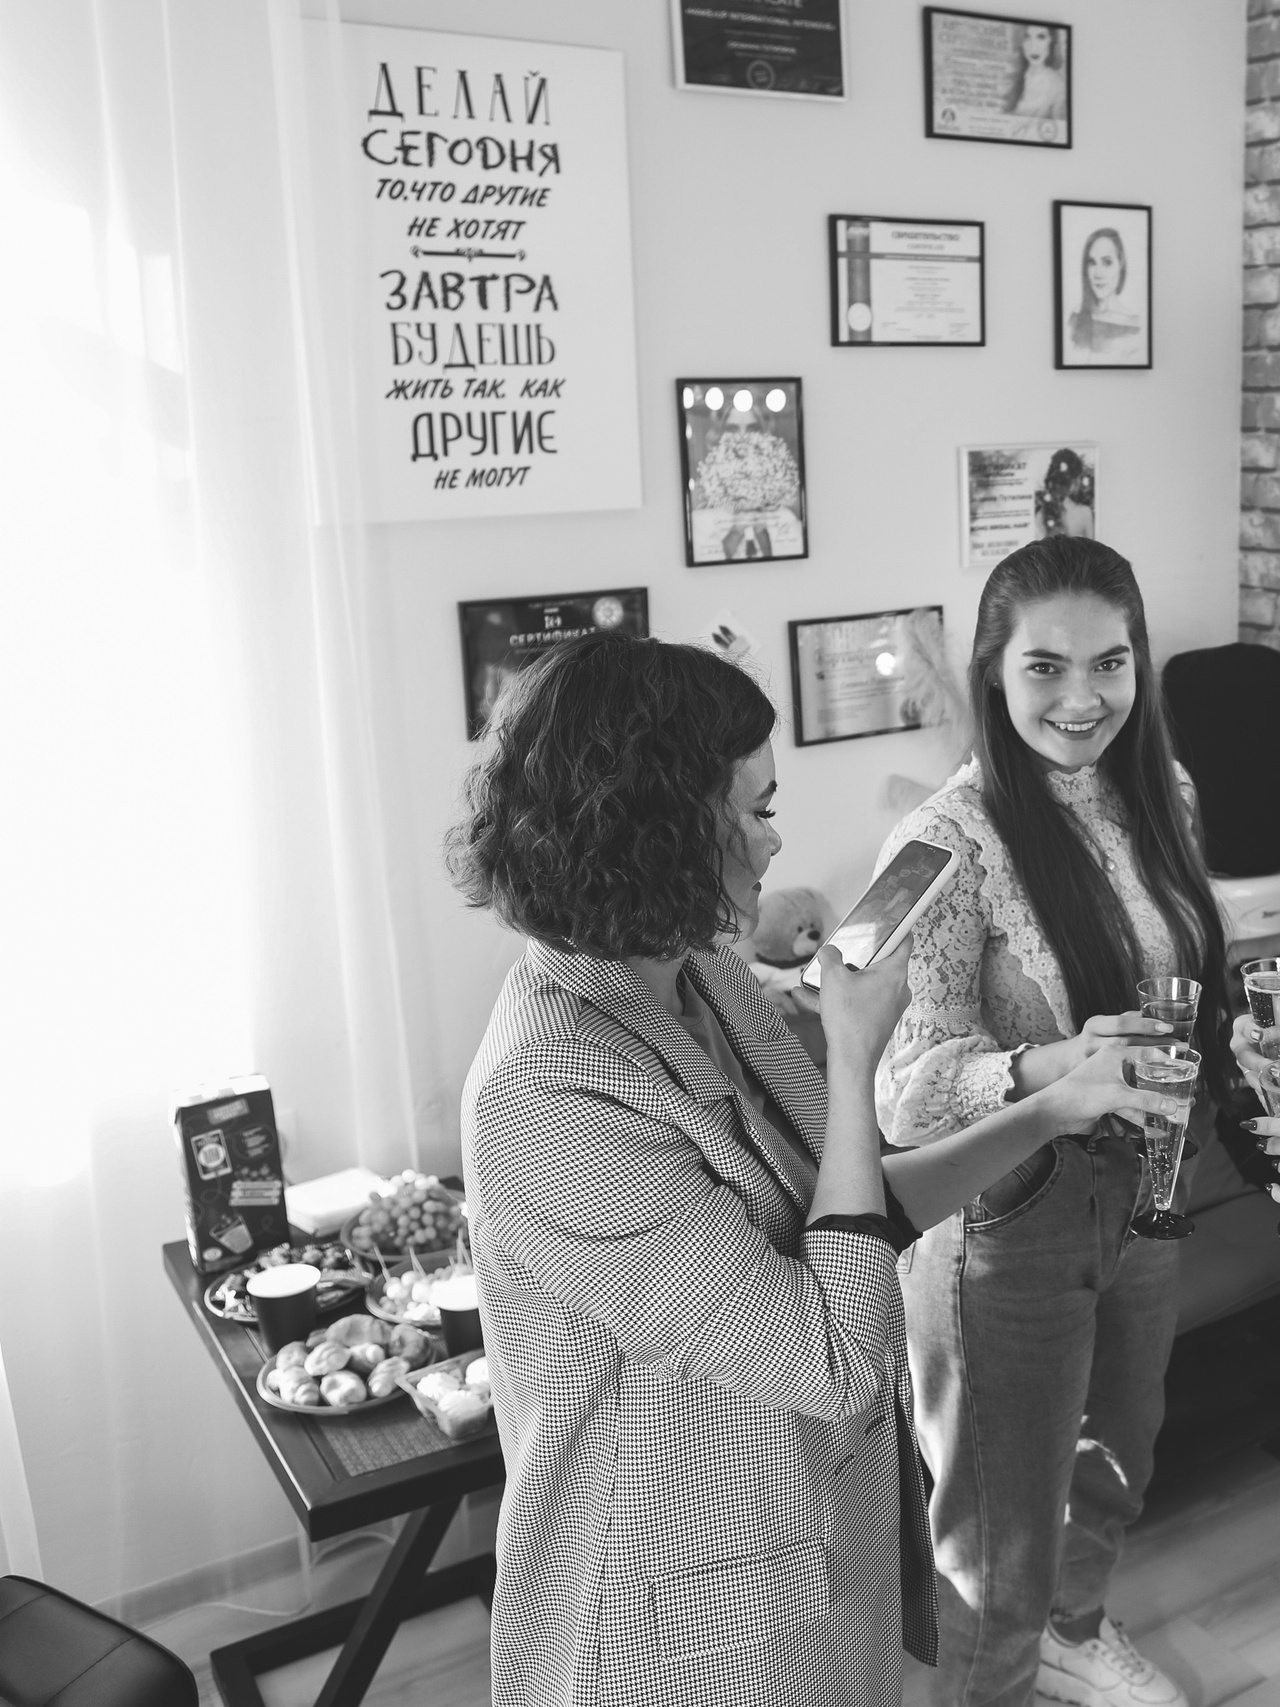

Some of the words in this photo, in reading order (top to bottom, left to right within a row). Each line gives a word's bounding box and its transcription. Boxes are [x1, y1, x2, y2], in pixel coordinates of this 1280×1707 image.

[367, 62, 551, 126] ДЕЛАЙ
[361, 128, 562, 178] СЕГОДНЯ
[459, 183, 552, 209] ДРУГИЕ
[406, 215, 442, 240] НЕ
[445, 217, 528, 243] ХОТЯТ
[378, 268, 560, 314] ЗАВТРА
[389, 321, 557, 372] БУДЕШЬ
[384, 377, 455, 401] ЖИТЬ
[519, 377, 567, 401] КАК
[409, 409, 559, 464] ДРУГИЕ
[433, 468, 463, 492] НЕ
[463, 465, 533, 490] МОГУТ
